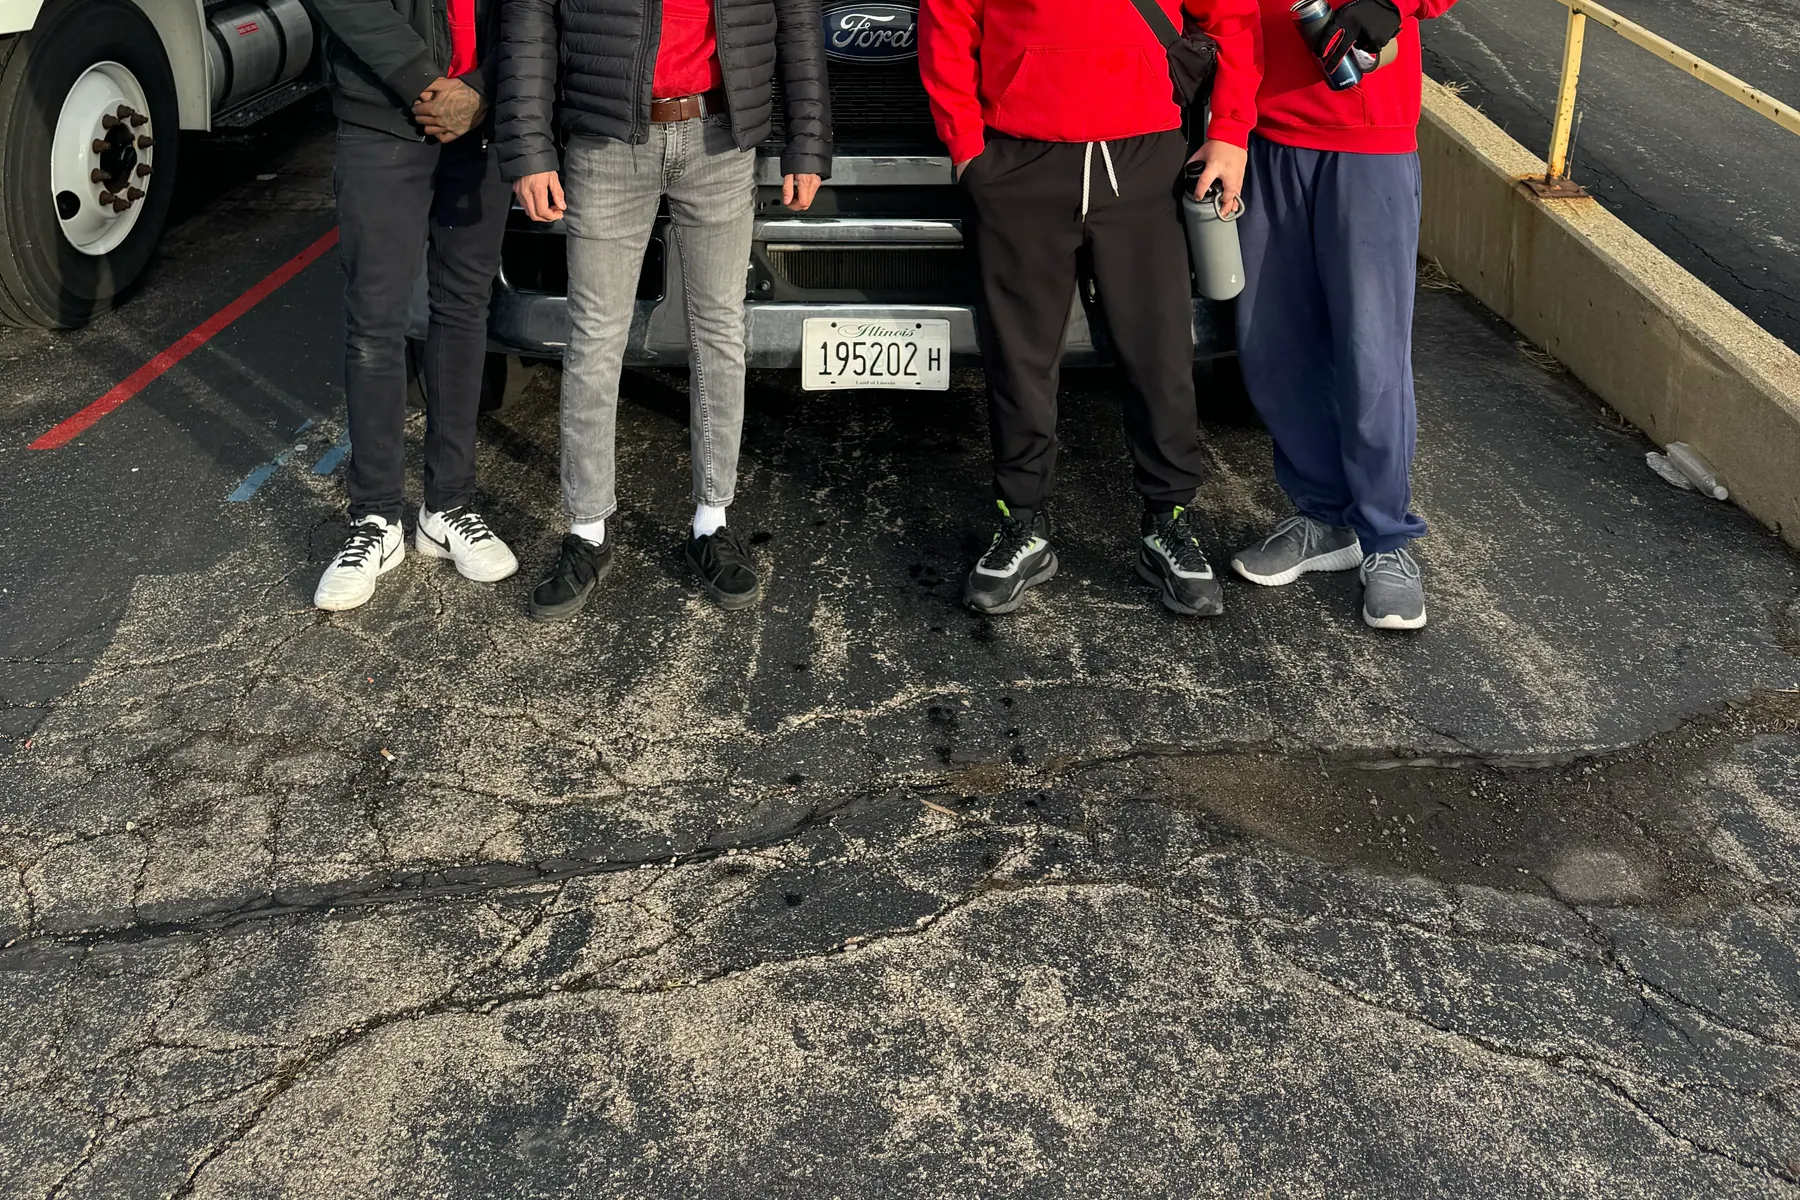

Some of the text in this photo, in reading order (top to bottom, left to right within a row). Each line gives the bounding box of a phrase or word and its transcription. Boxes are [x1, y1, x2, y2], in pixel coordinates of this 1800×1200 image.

[832, 13, 916, 48] Ford
[837, 324, 916, 339] Illinois
[818, 341, 941, 376] 195202 H
